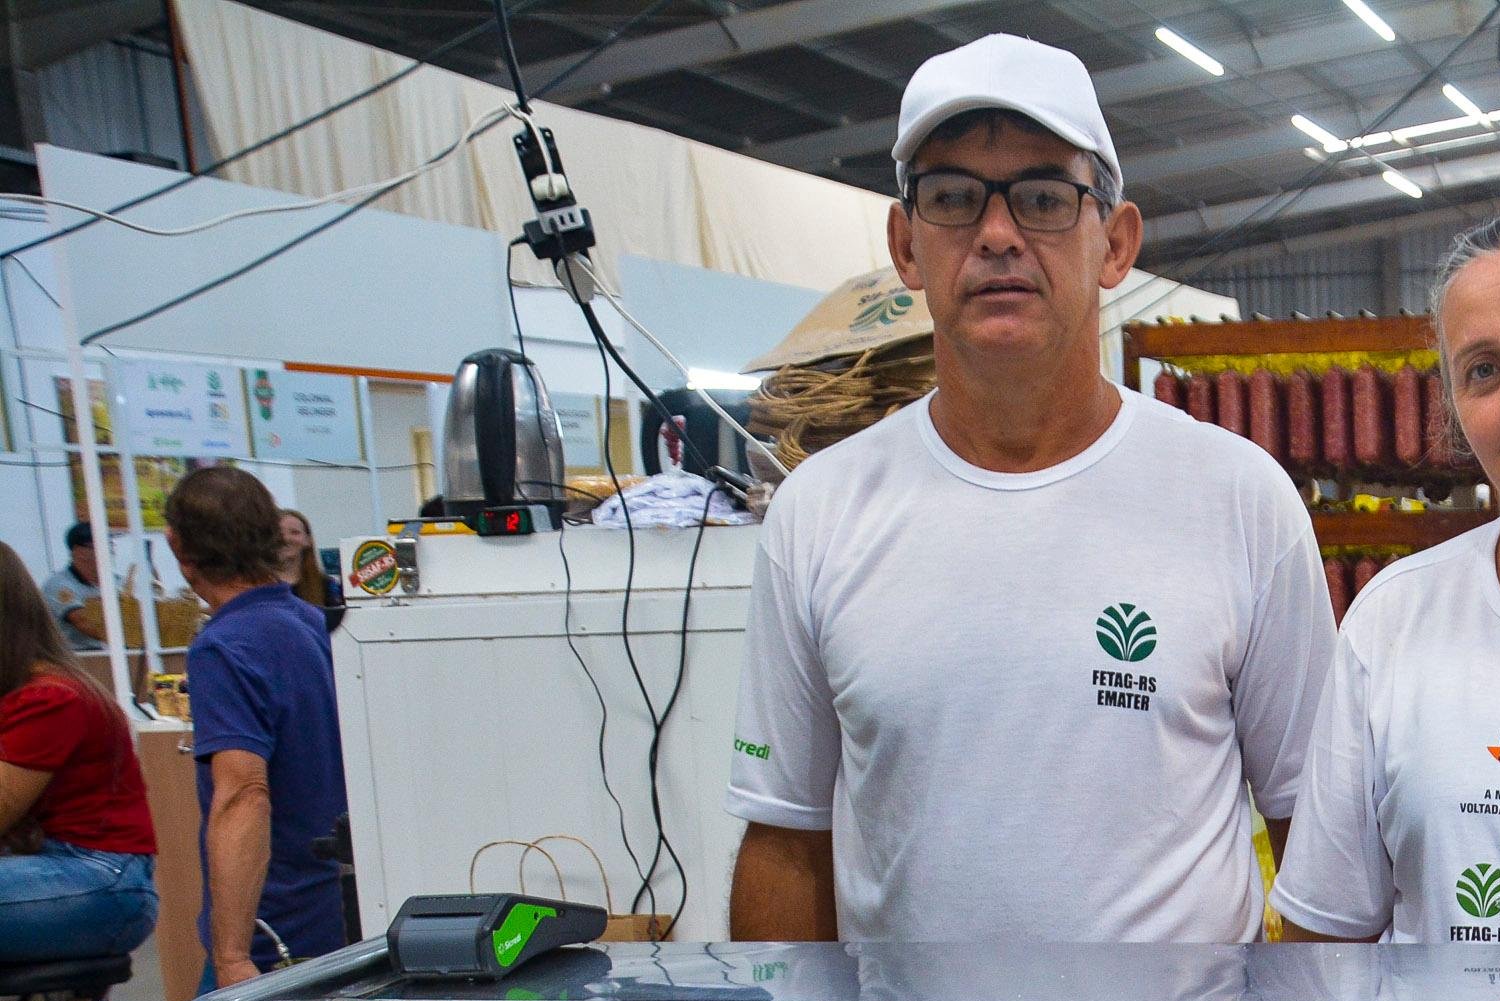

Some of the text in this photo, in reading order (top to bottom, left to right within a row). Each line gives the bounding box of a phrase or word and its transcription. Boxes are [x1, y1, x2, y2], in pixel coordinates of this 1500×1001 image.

[1092, 669, 1157, 693] FETAG-RS
[1097, 689, 1150, 711] EMATER
[1484, 790, 1492, 799] A
